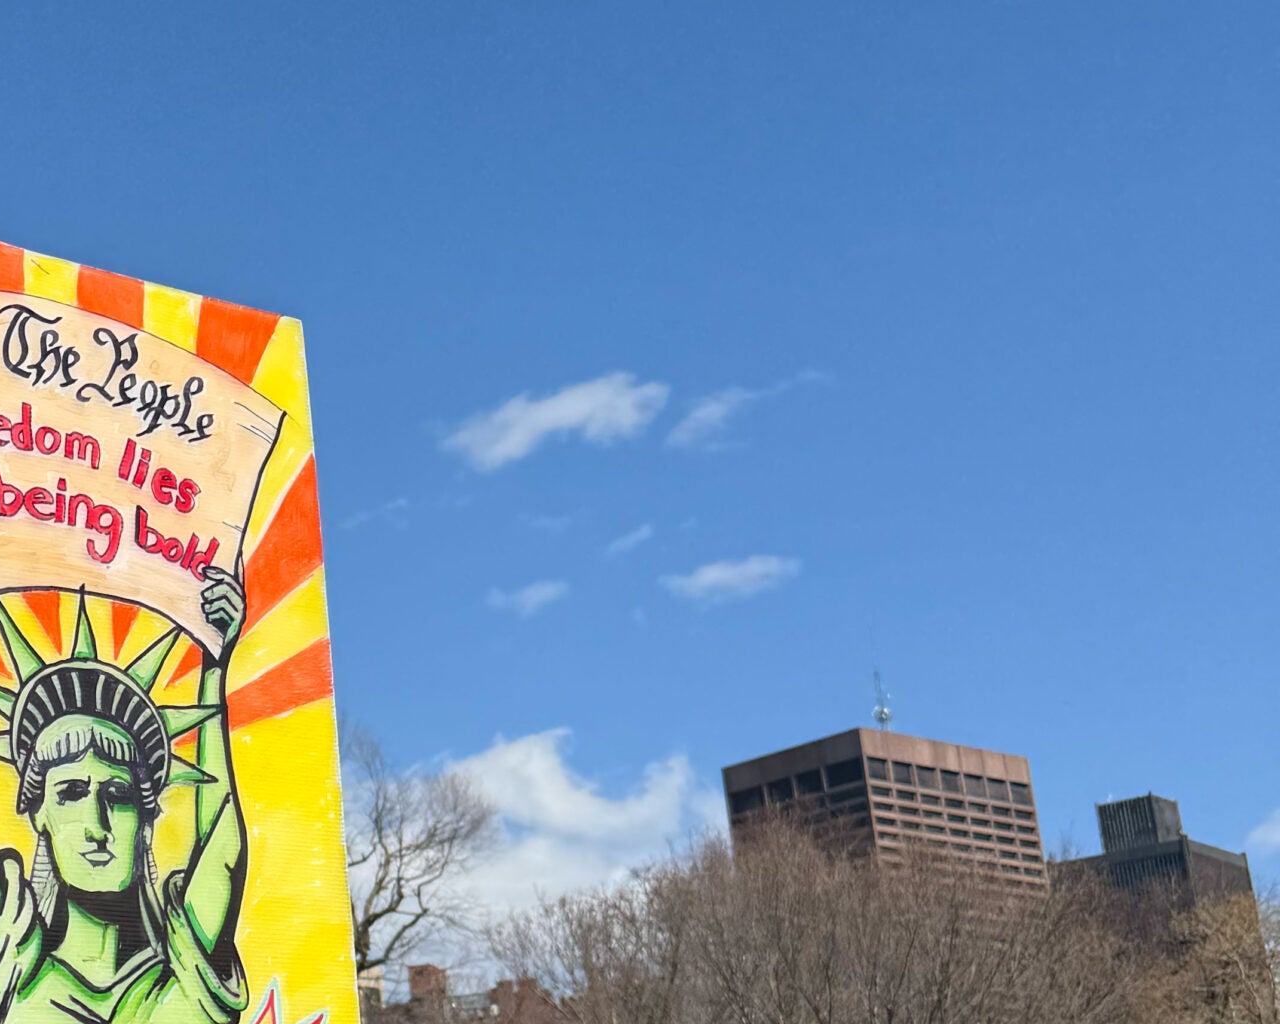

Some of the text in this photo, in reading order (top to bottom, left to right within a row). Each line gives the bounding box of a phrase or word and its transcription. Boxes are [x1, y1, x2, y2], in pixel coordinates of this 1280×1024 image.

[76, 328, 214, 442] People
[118, 438, 201, 514] lies
[135, 505, 219, 582] bold
